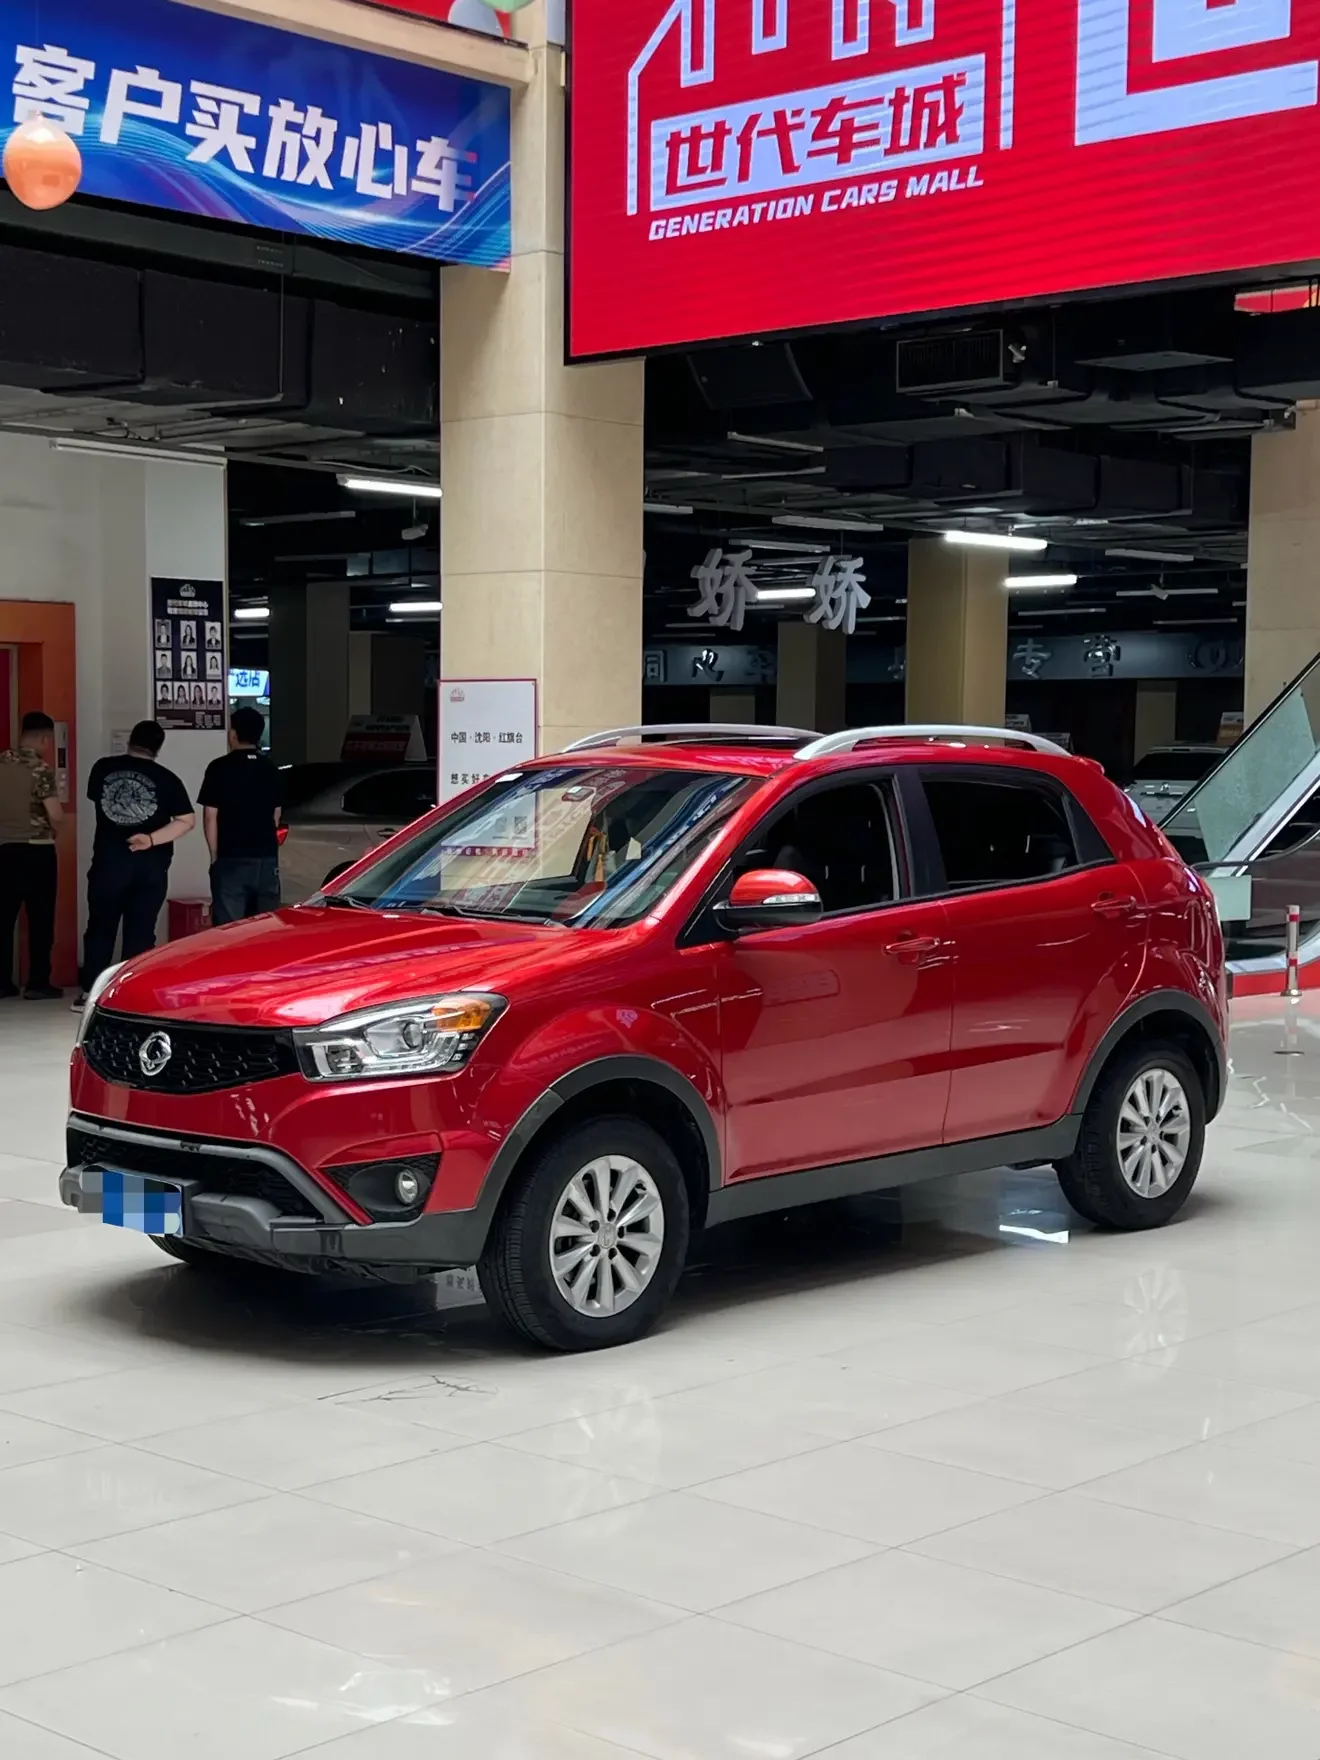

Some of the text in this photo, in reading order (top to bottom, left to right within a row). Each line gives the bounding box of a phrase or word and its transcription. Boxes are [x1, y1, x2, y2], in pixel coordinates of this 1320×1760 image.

[12, 44, 477, 213] 客户买放心车
[665, 71, 967, 196] 世代车城
[649, 166, 983, 240] GENERATION CARS MALL
